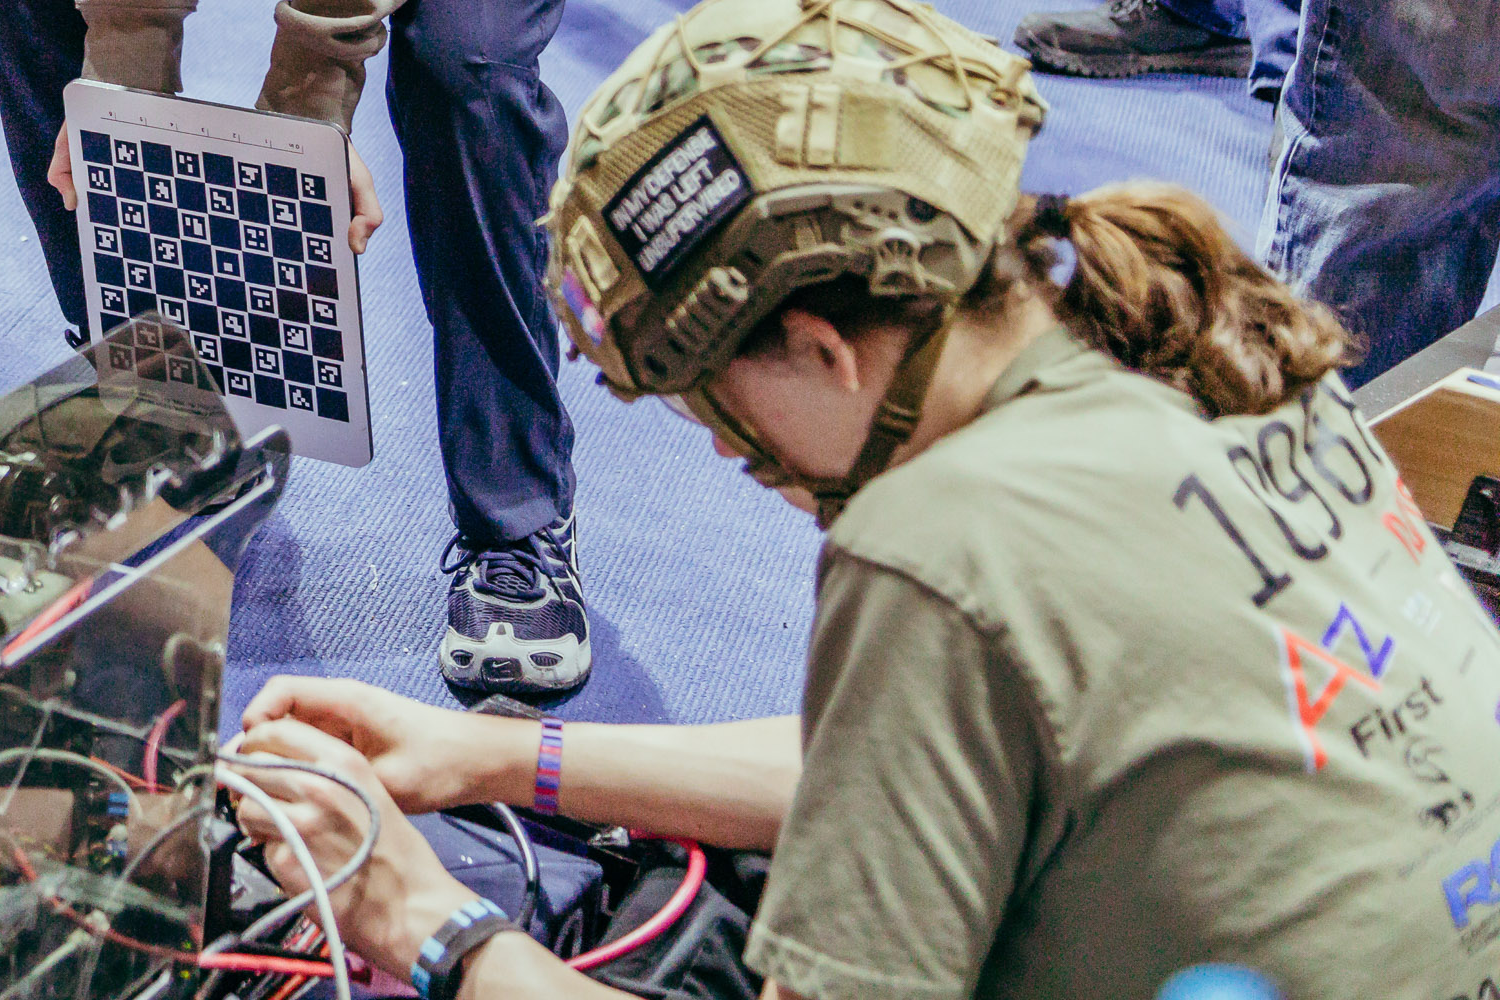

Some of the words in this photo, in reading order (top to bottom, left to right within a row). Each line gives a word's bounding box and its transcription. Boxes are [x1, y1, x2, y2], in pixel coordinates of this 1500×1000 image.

[642, 127, 717, 197] DEFENSE
[669, 156, 714, 203] LEFT
[631, 221, 649, 244] I
[637, 192, 677, 233] WAS
[637, 168, 741, 272] UNSUPERVISED
[1350, 677, 1442, 759] First
